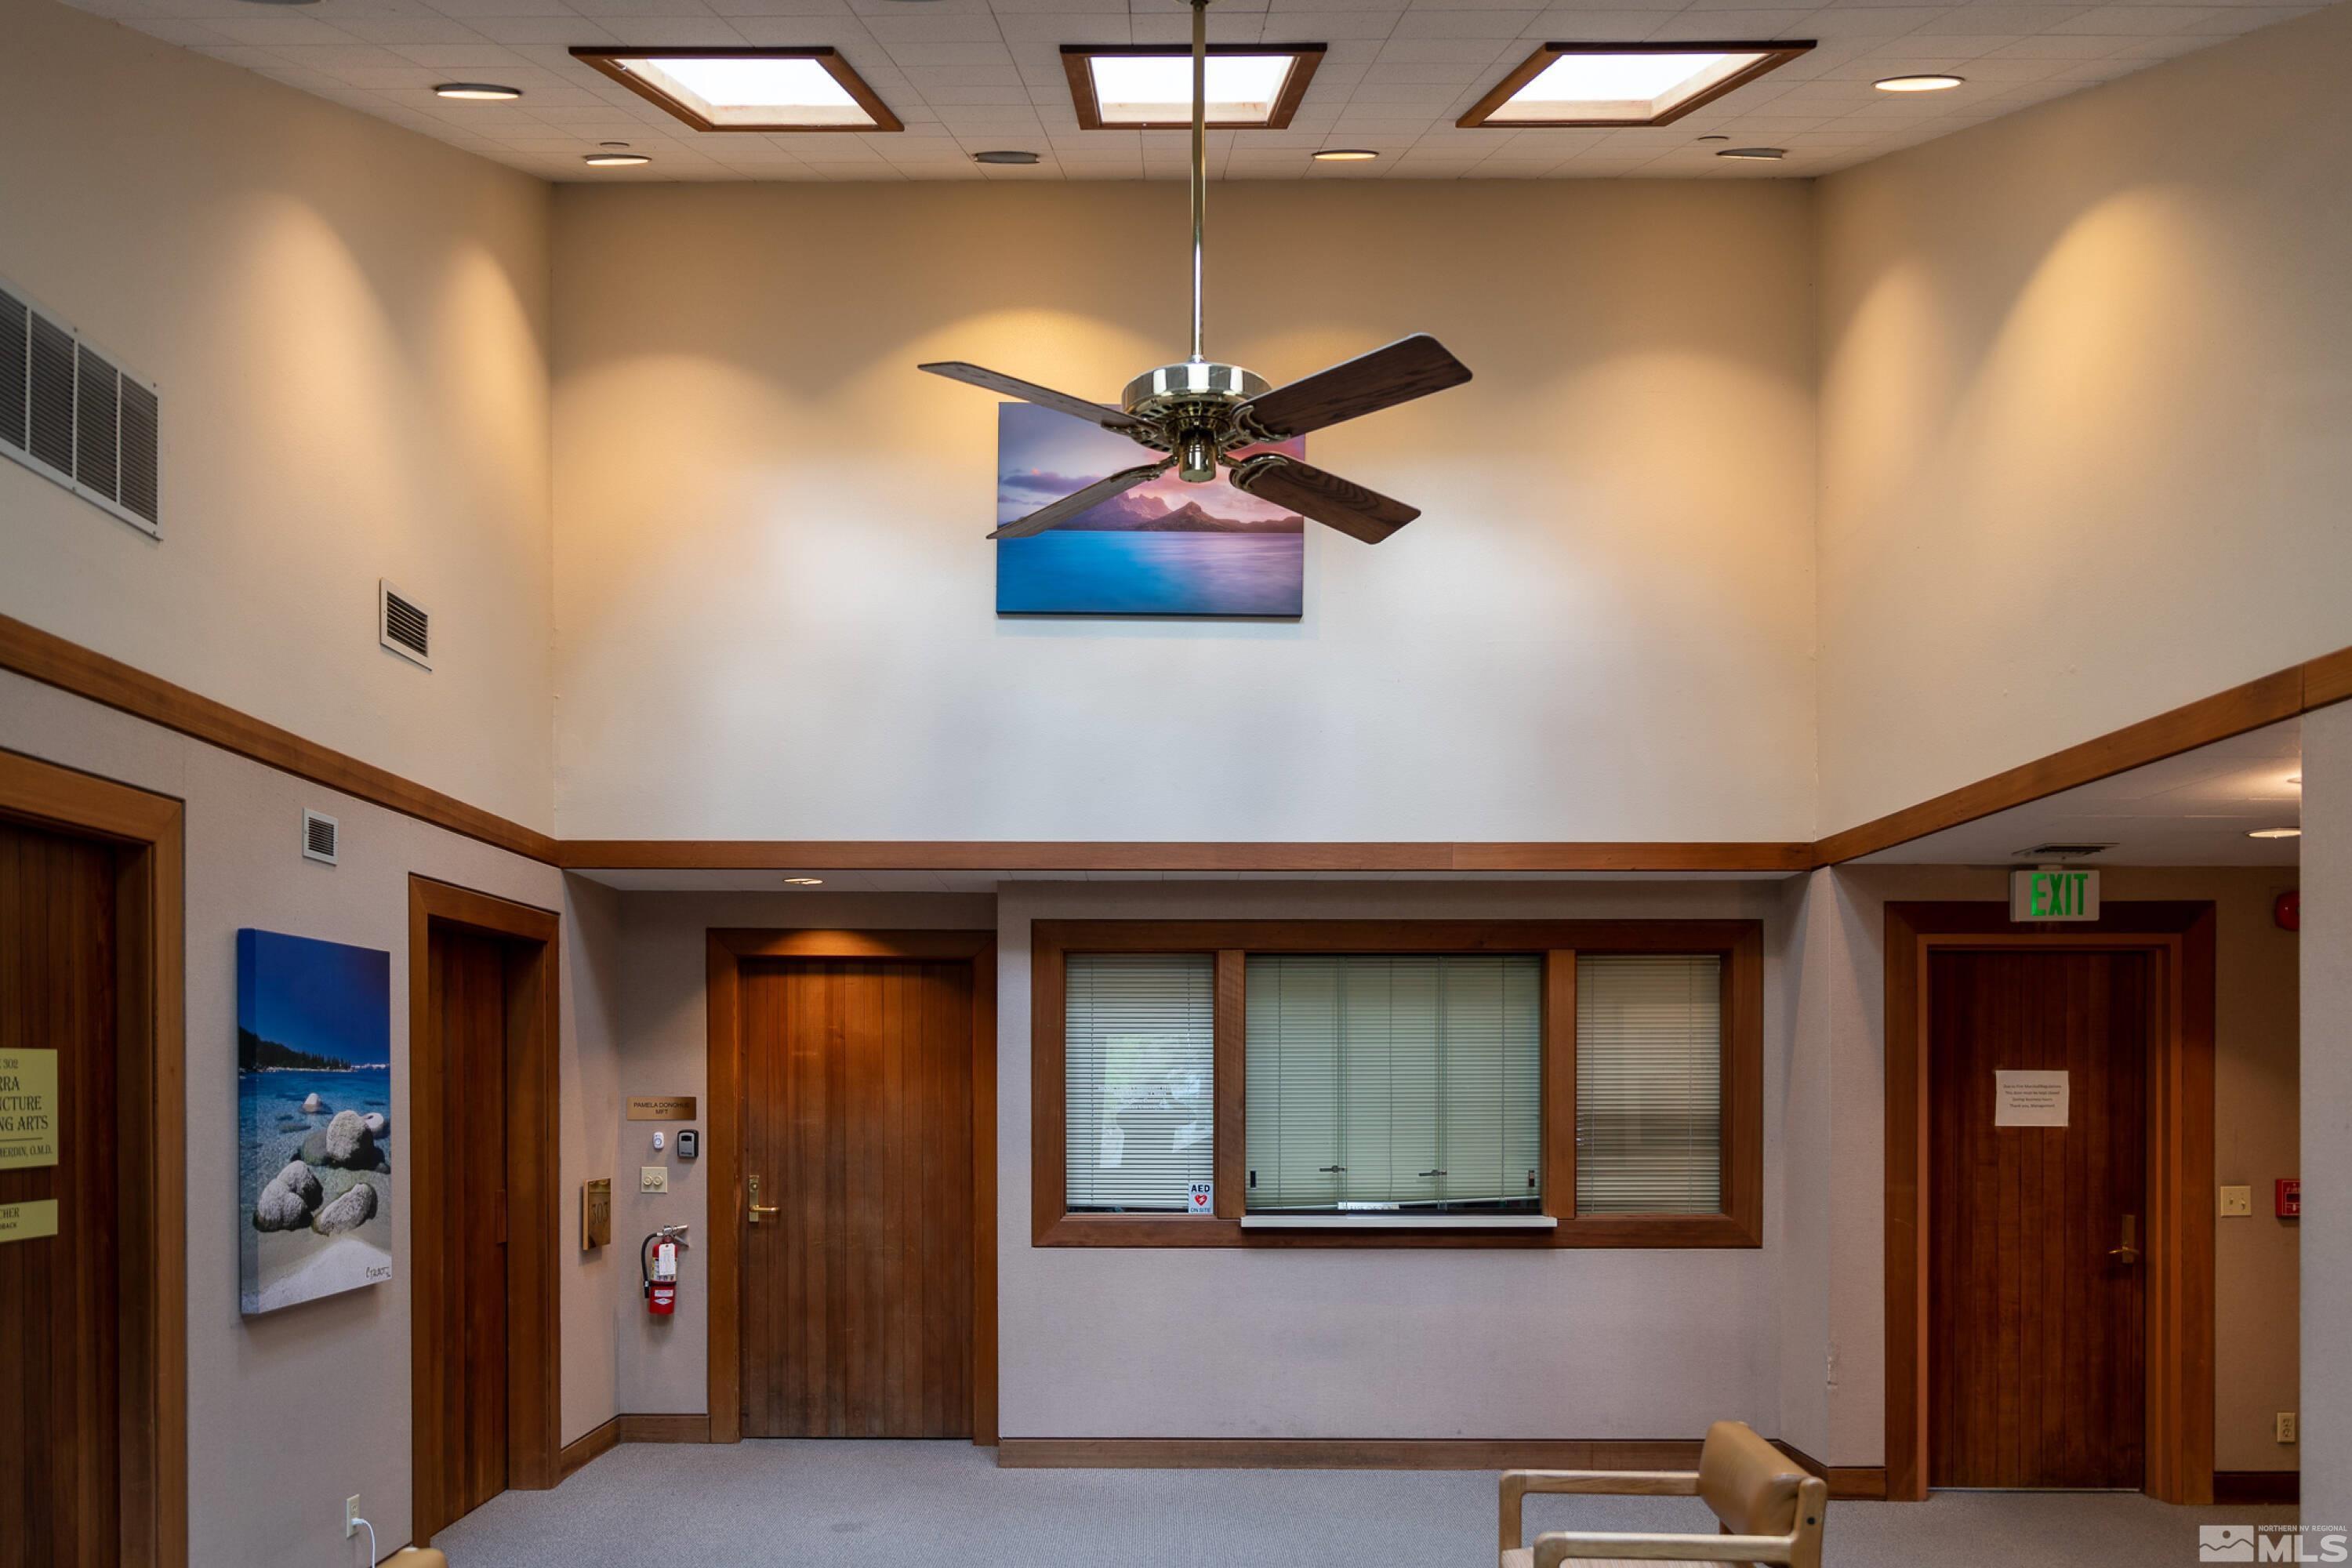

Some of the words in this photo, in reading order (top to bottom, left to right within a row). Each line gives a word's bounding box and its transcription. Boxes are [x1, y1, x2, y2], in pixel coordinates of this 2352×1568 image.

[2031, 873, 2088, 916] EXIT
[3, 1058, 19, 1069] 302
[0, 1095, 42, 1111] CTURE
[17, 1115, 49, 1131] ARTS
[592, 1202, 609, 1225] 303
